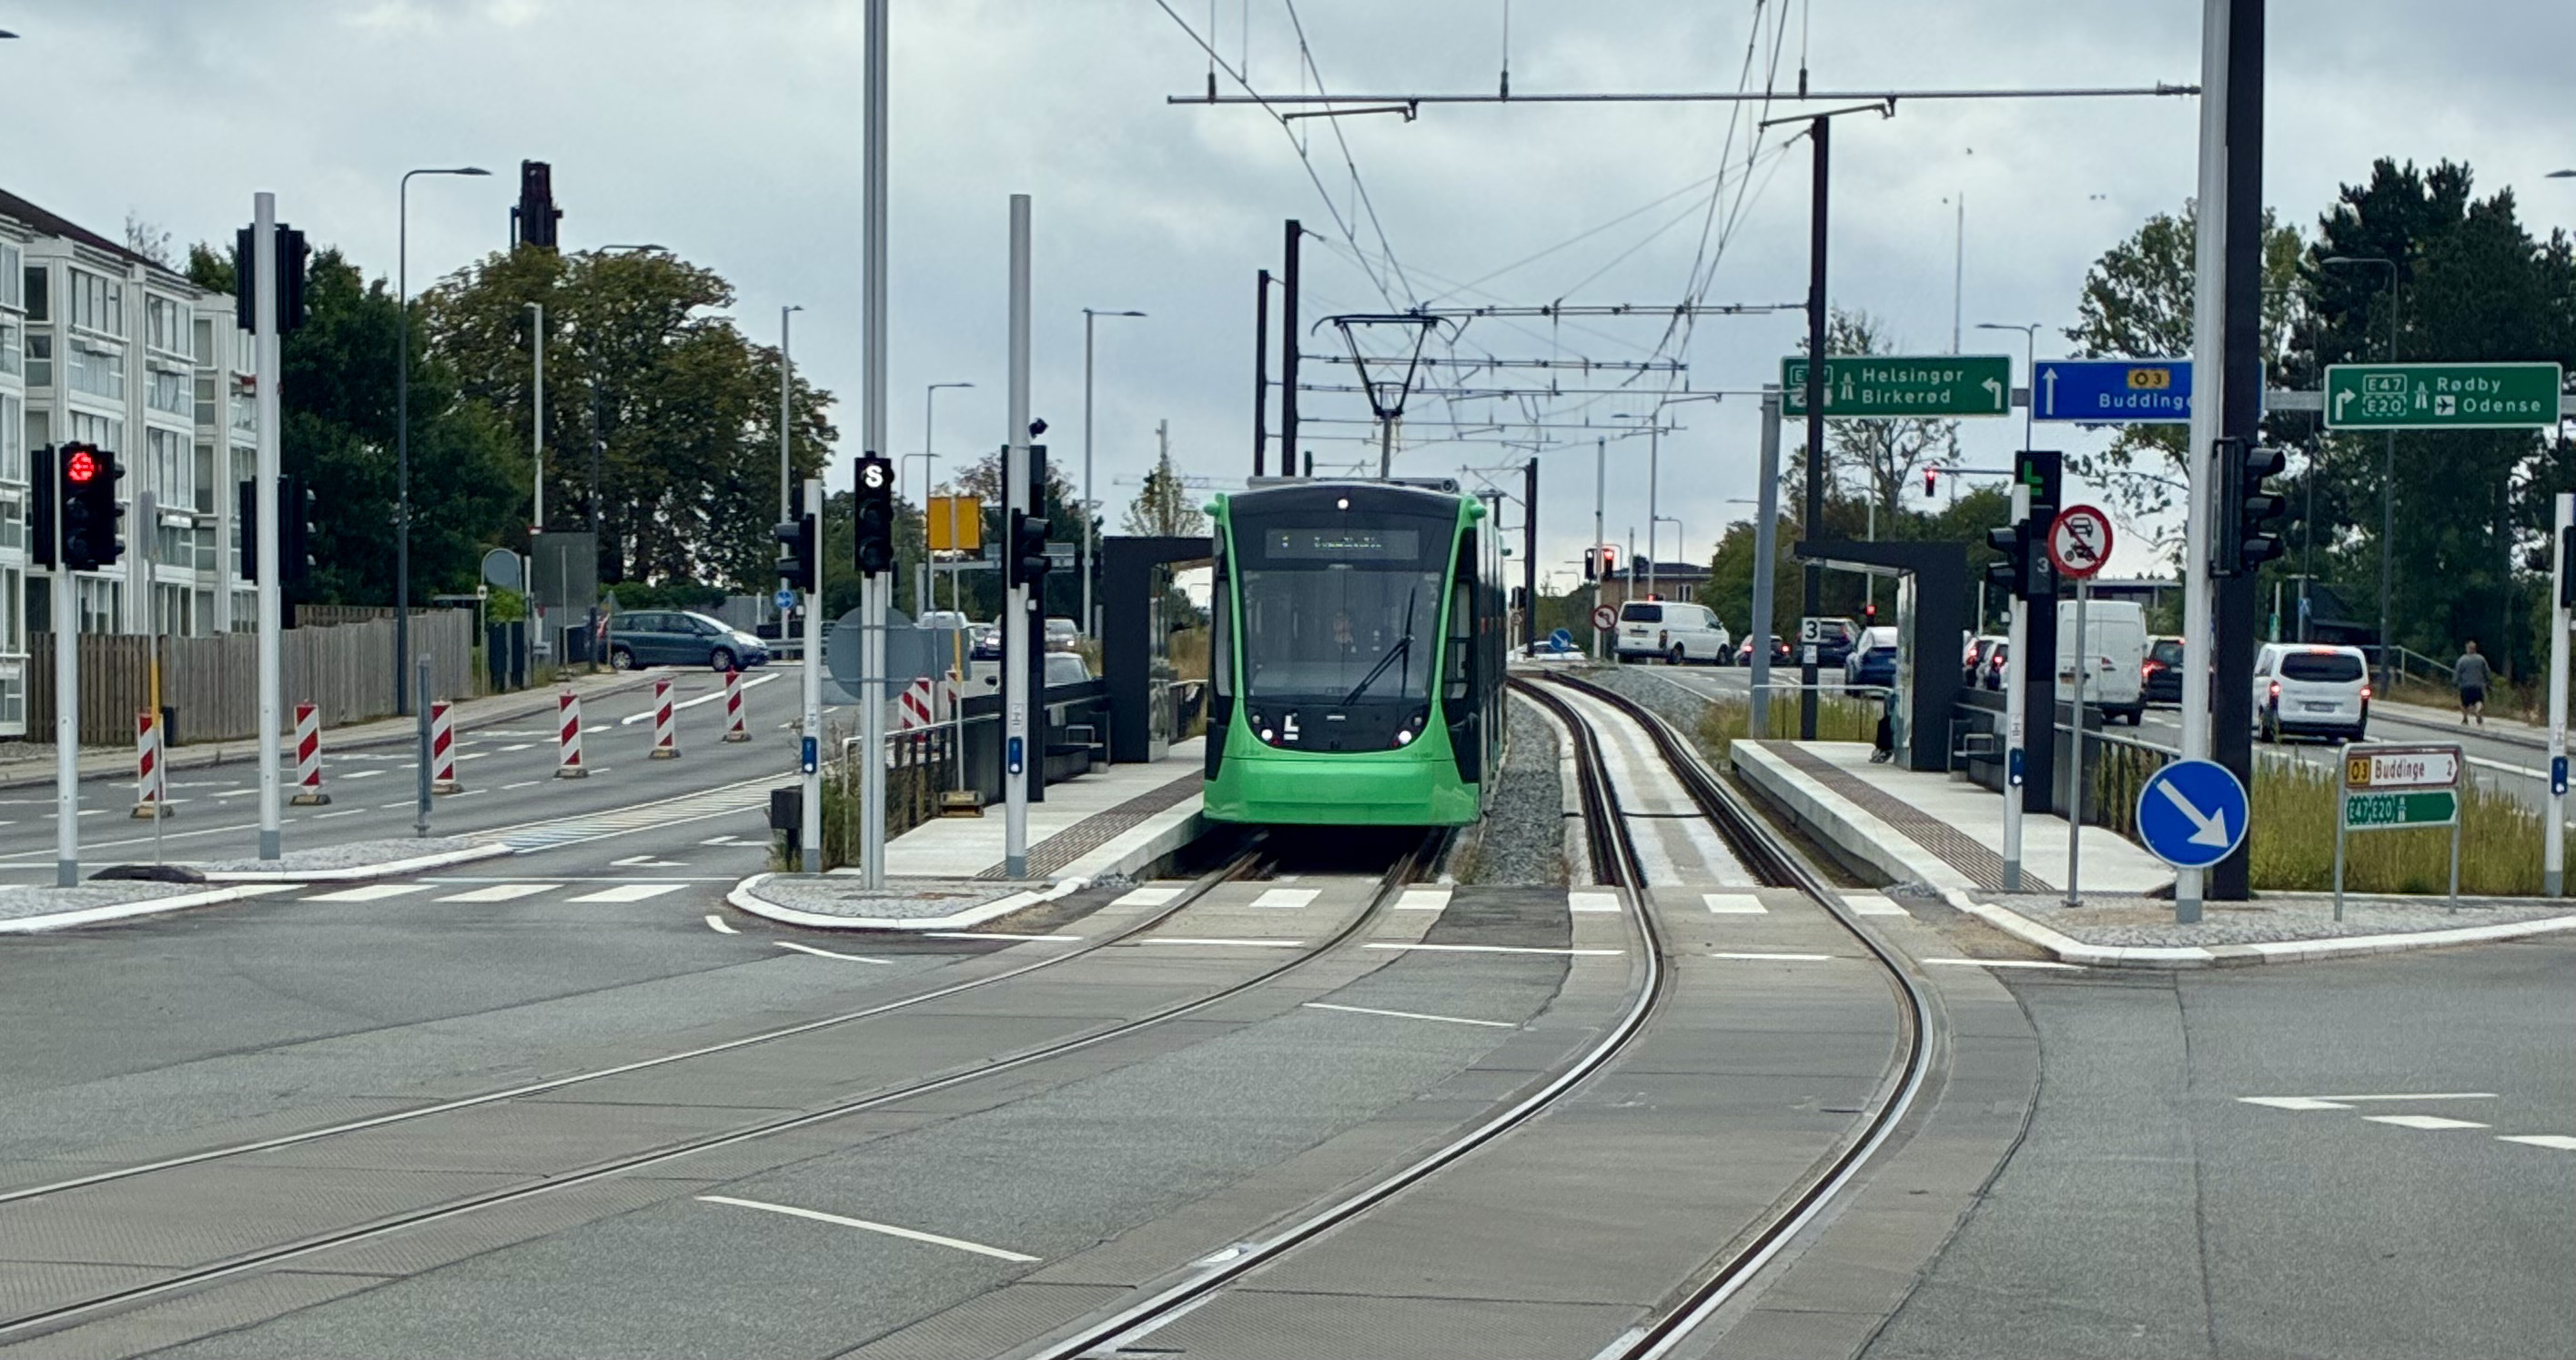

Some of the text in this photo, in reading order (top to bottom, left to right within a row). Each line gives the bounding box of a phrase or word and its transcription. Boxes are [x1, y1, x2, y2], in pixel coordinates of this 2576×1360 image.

[1862, 368, 1964, 386] Helsingør
[2368, 378, 2403, 391] E47
[2437, 377, 2501, 394] Rødby
[1862, 388, 1951, 405] Birkerød
[2463, 398, 2541, 412] Odense
[2367, 399, 2402, 412] E20
[1805, 620, 1817, 640] 3
[2374, 759, 2425, 781] Buddinge
[2446, 761, 2452, 776] 2
[2349, 801, 2393, 820] E47 E20
